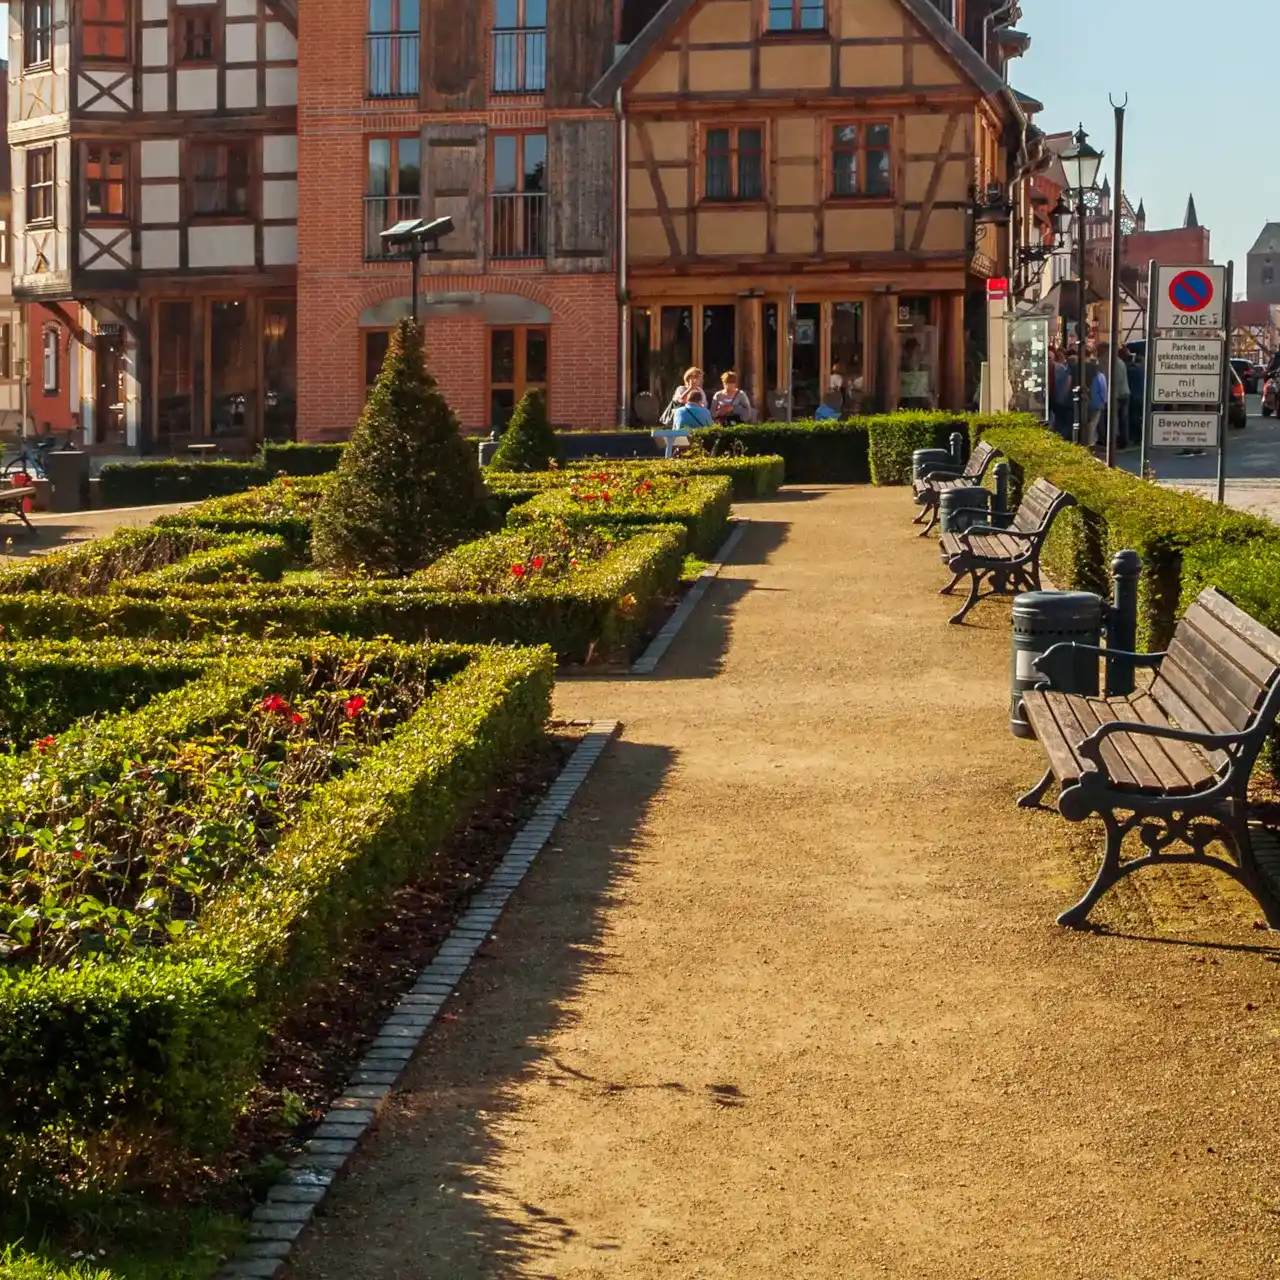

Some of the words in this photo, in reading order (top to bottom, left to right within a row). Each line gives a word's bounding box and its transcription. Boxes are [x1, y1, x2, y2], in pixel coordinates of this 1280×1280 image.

[1172, 314, 1208, 326] ZONE
[1172, 342, 1196, 351] Parken
[1198, 343, 1206, 351] in
[1157, 353, 1219, 362] gekennzeichneten
[1160, 361, 1188, 370] Flächen
[1190, 362, 1215, 371] erlaubt
[1178, 378, 1196, 387] mit
[1157, 388, 1215, 398] Parkschein
[1158, 418, 1212, 428] Bewohner
